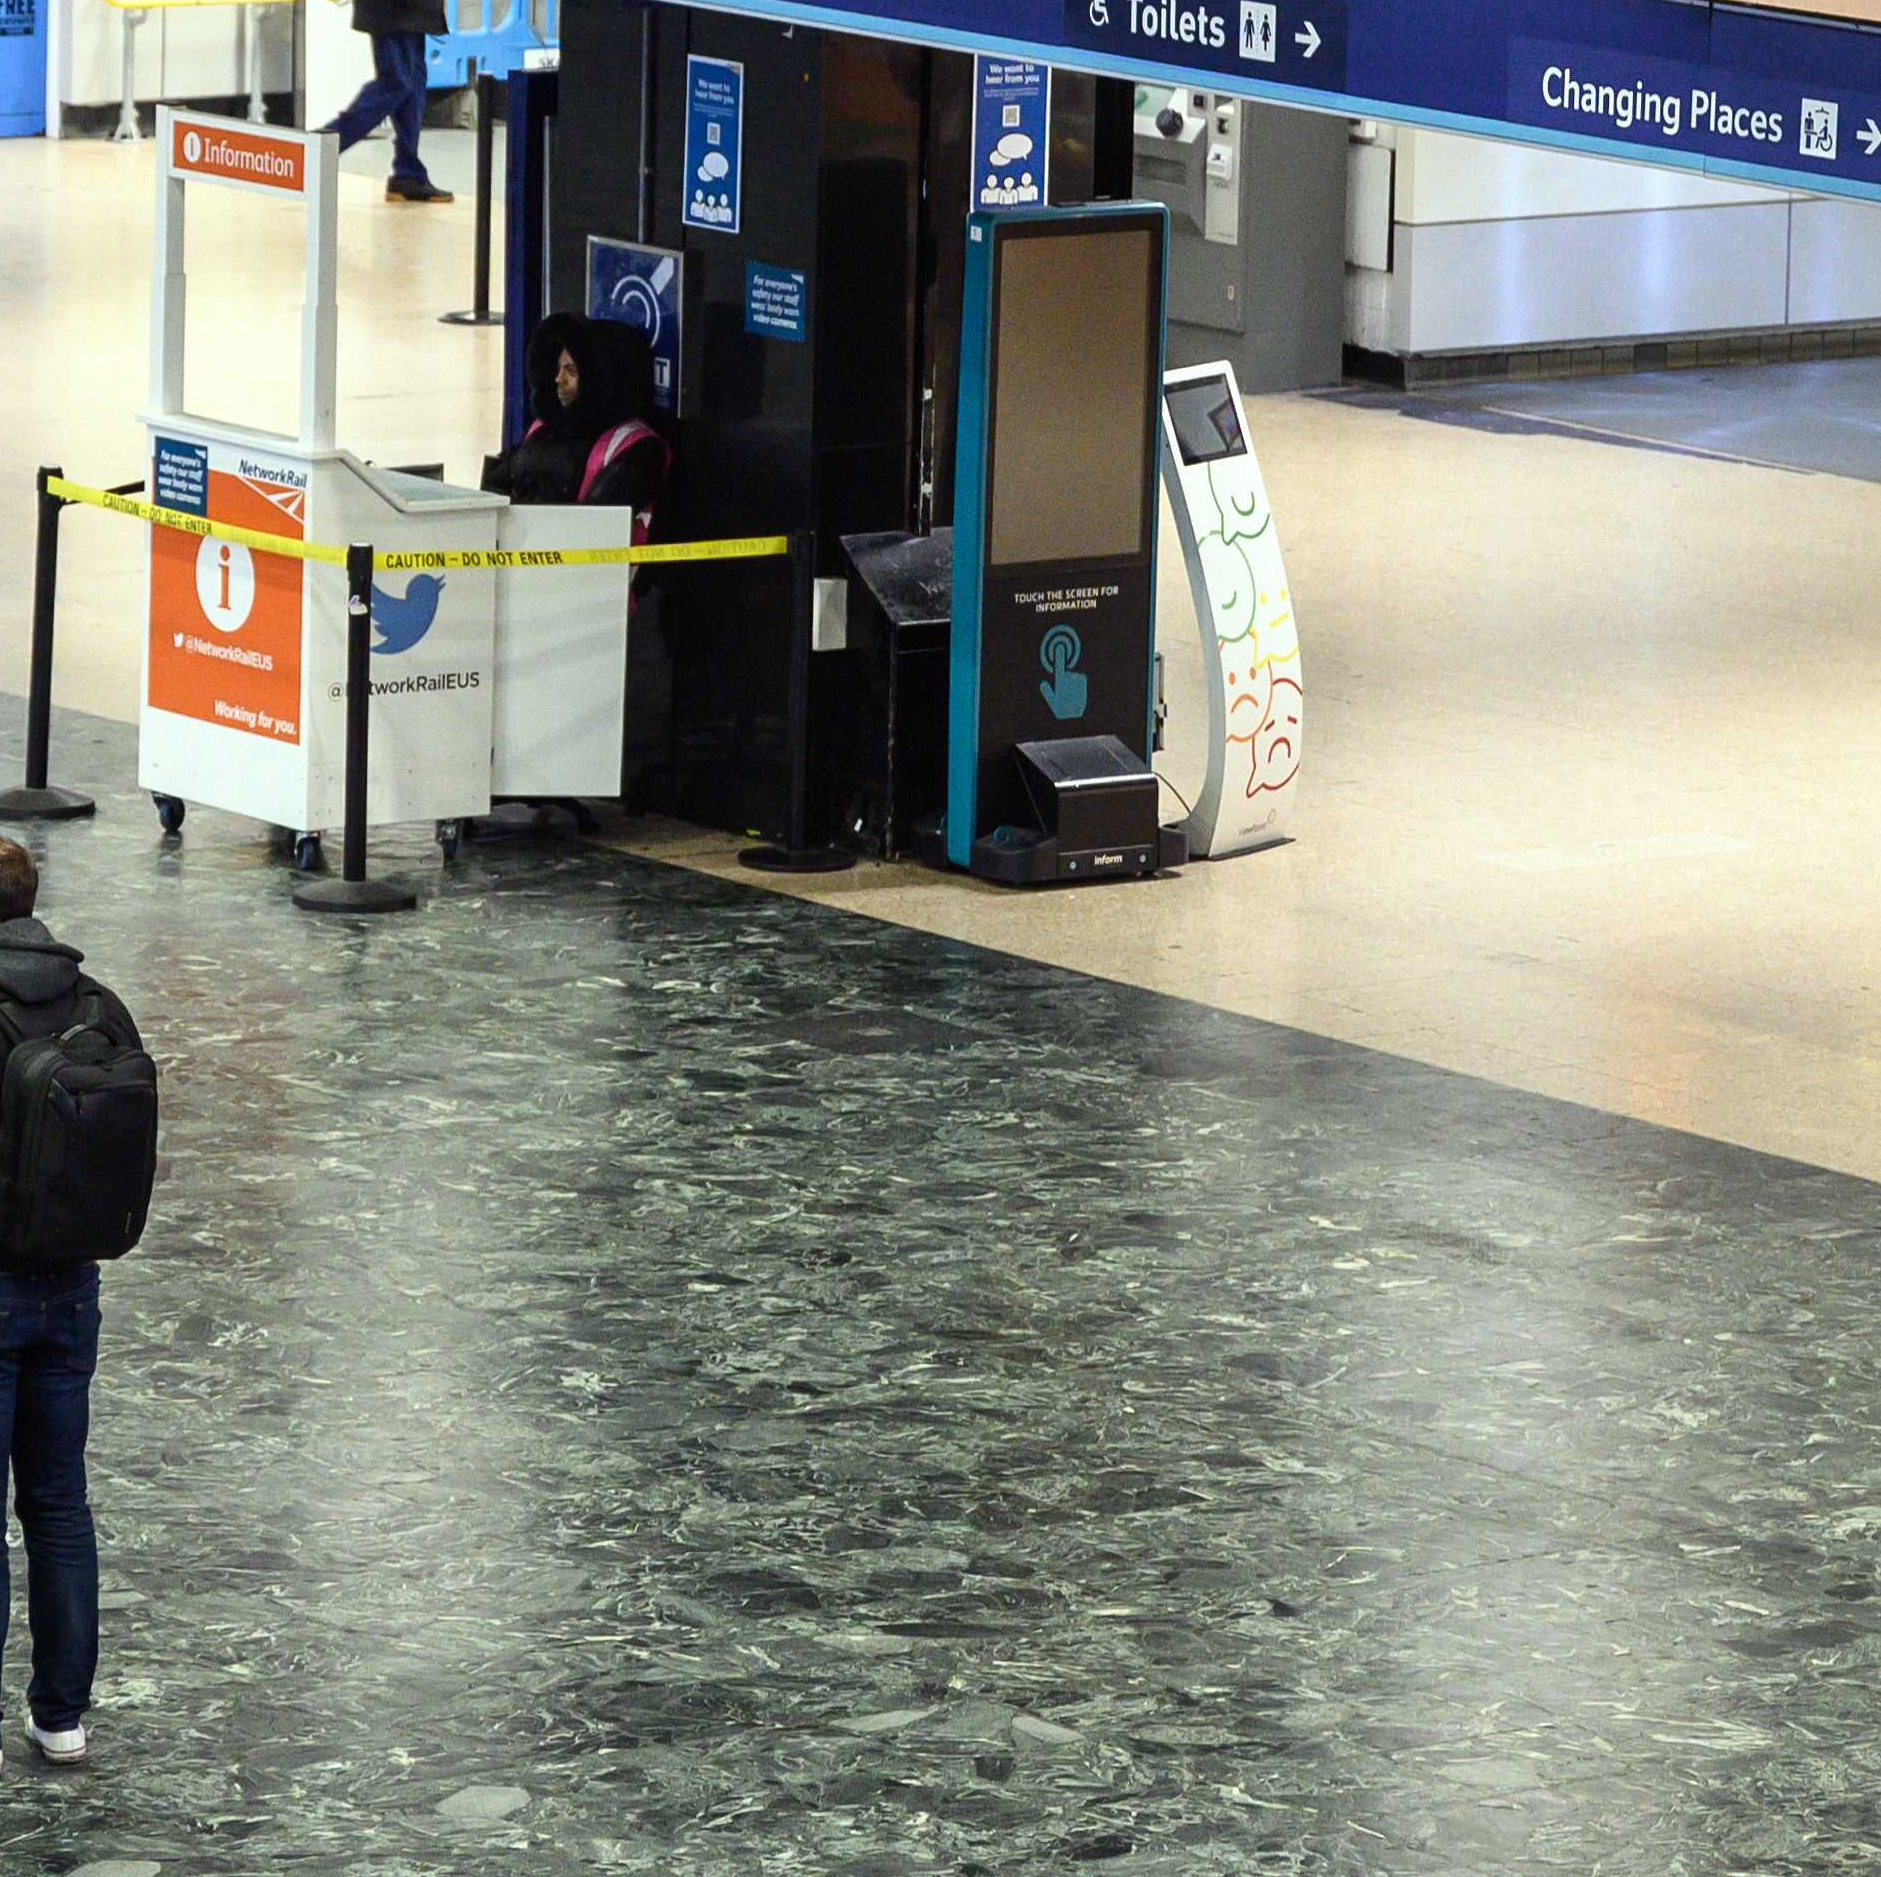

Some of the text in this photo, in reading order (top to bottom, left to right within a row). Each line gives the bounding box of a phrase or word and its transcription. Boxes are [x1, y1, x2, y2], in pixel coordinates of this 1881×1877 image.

[1540, 66, 1784, 144] Changing Places
[204, 137, 294, 178] Information
[239, 459, 308, 488] NetworkRail
[102, 493, 213, 535] CAUTION DO NOT ENTER
[385, 550, 564, 569] CAUTION DO NOT ENTER
[1014, 585, 1119, 604] TOUCH THE SCREEN FOR
[1034, 599, 1097, 613] INFORMATION
[185, 634, 273, 671] @NetworkRailEUS
[327, 671, 480, 702] @tworkRailEUS
[214, 699, 297, 736] Working for you.
